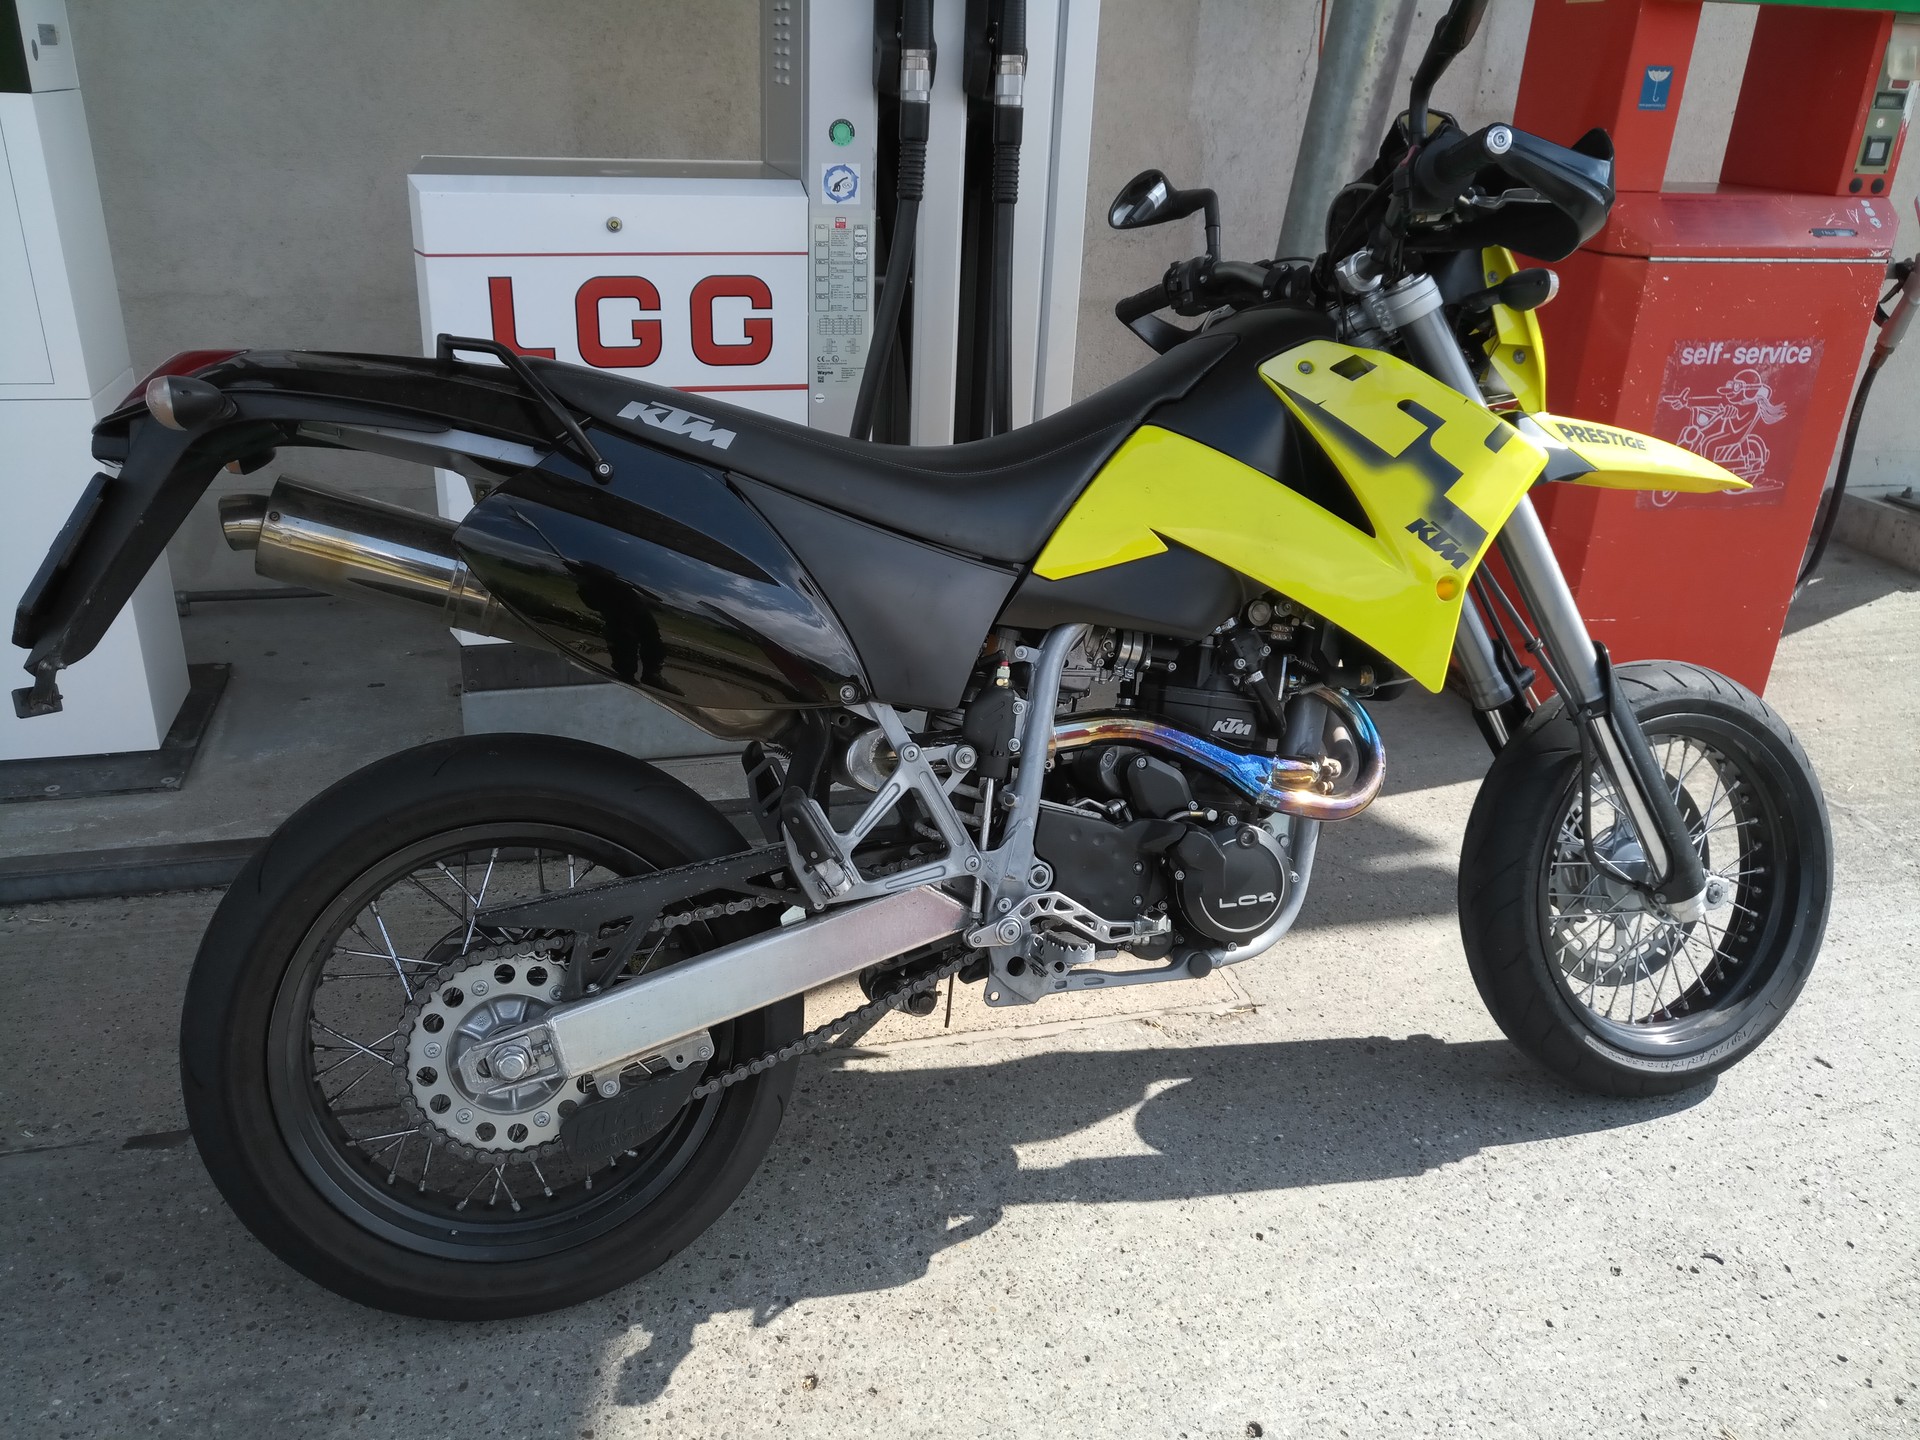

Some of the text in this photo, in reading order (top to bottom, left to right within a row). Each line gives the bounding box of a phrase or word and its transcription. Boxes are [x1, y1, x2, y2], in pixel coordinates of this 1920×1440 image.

[488, 275, 773, 367] LGG
[1680, 341, 1812, 365] self-service
[617, 401, 737, 449] KTM
[1555, 423, 1646, 450] PRESTIGE
[1404, 517, 1470, 570] KTM
[1212, 717, 1252, 735] KTM
[1219, 892, 1276, 908] LC4
